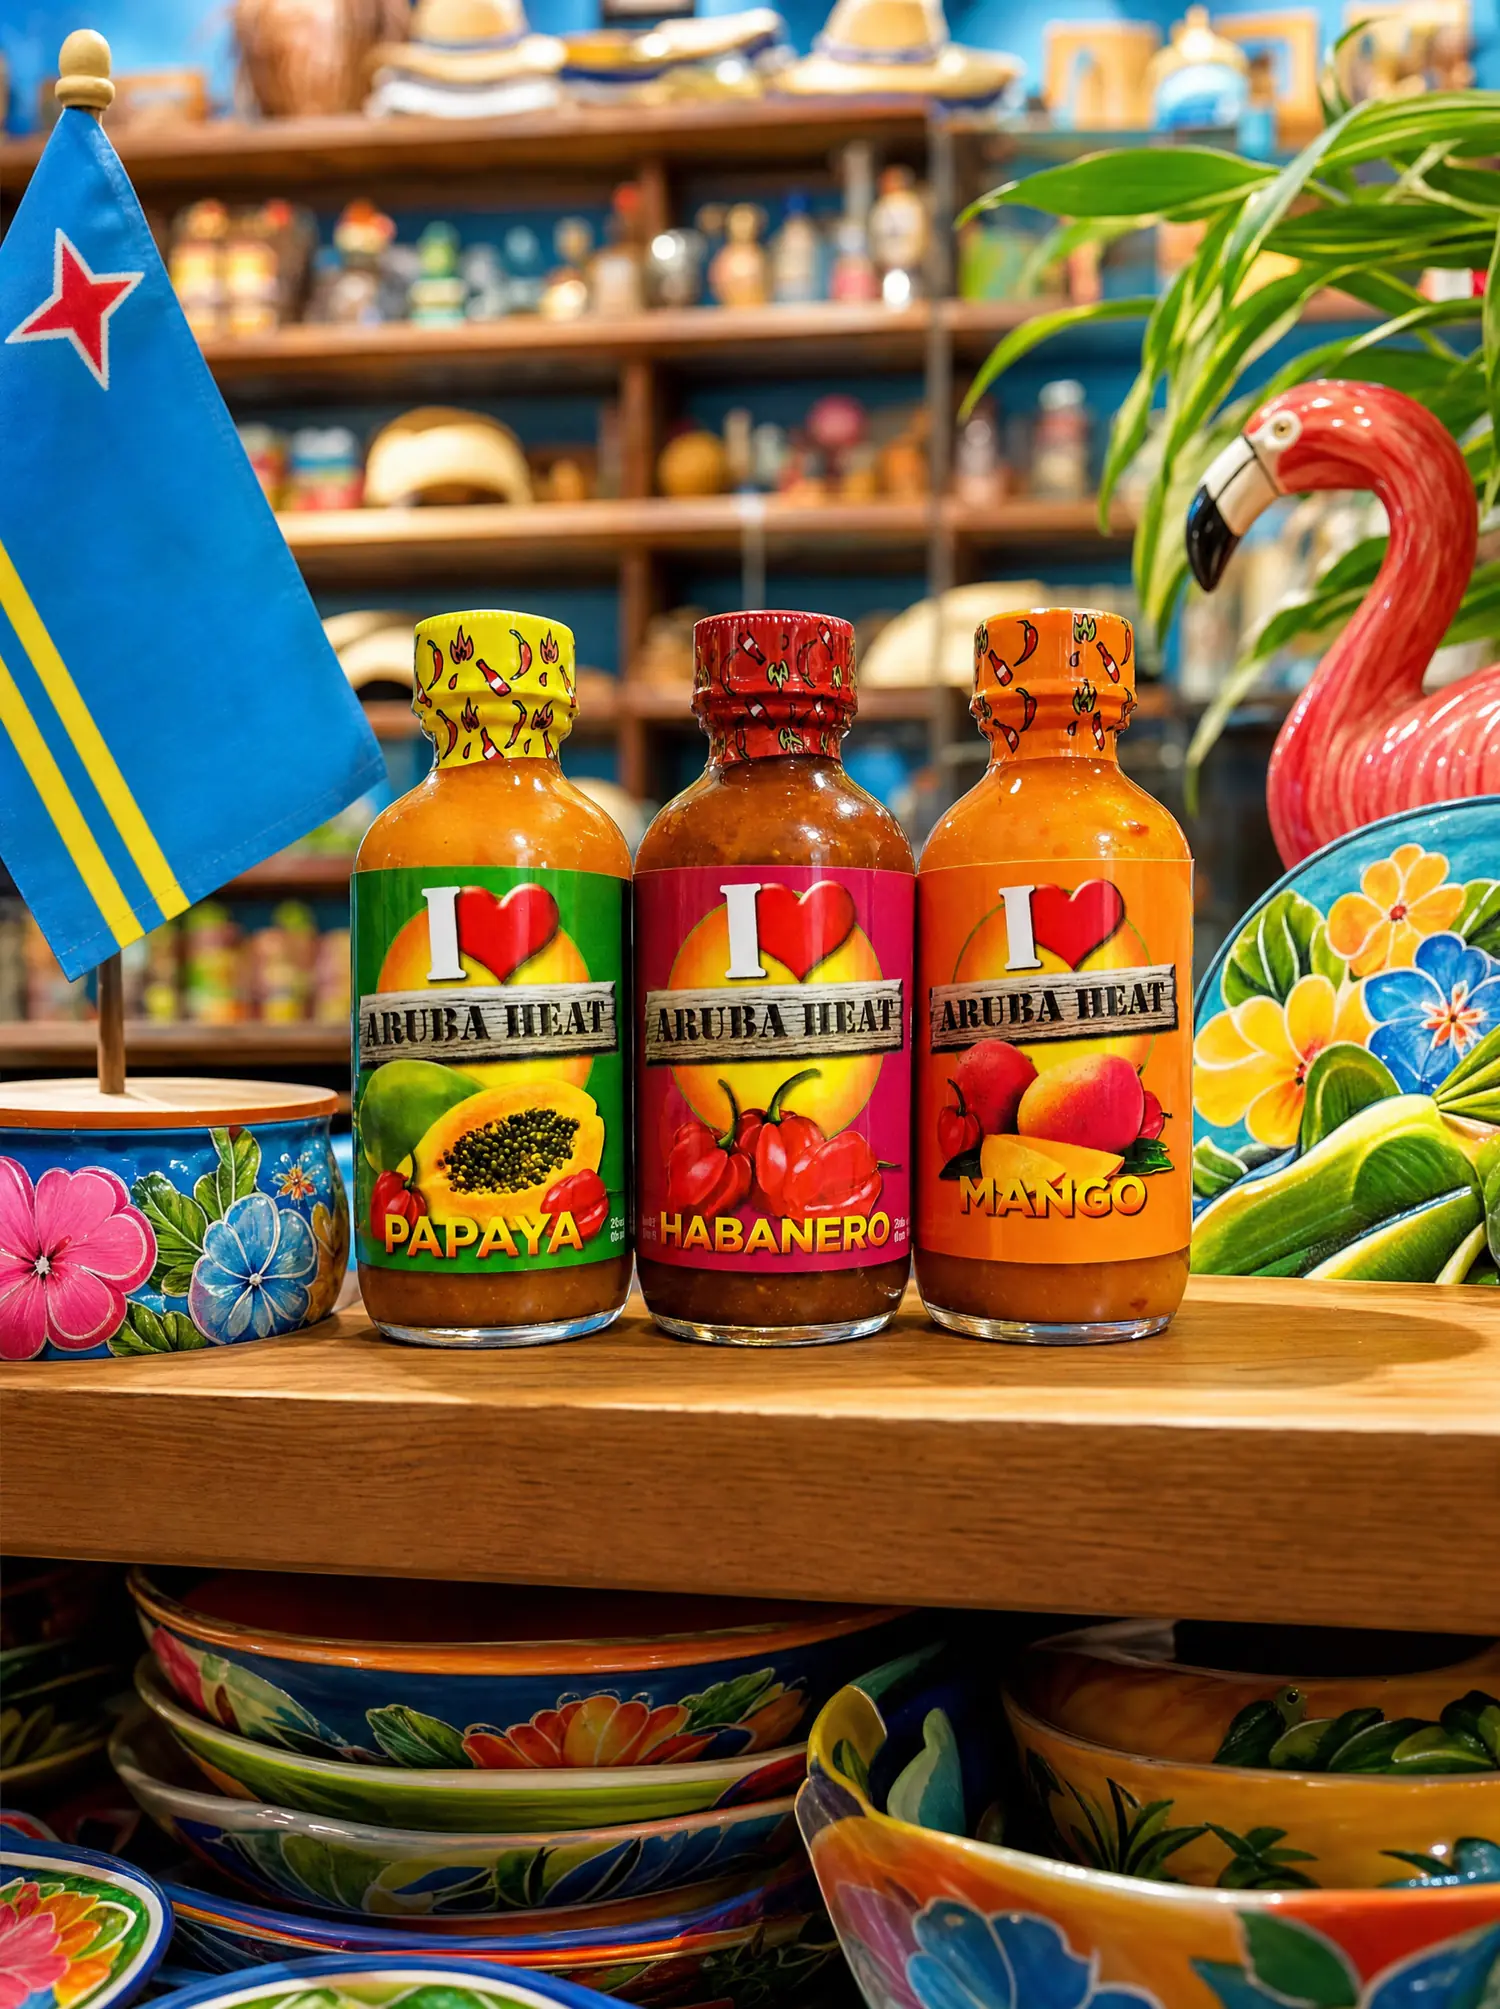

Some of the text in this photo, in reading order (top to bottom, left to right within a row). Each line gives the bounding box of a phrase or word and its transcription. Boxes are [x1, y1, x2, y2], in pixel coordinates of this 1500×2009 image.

[421, 886, 466, 980] I
[720, 883, 766, 978] I
[998, 884, 1042, 970] I
[365, 1000, 605, 1047] ARUBA HEAT
[655, 999, 894, 1042] ARUBA HEAT
[939, 981, 1165, 1032] ARUBA HEAT
[959, 1174, 1147, 1218] MANGO
[385, 1210, 584, 1258] PAPAYA
[660, 1211, 890, 1254] HABANERO
